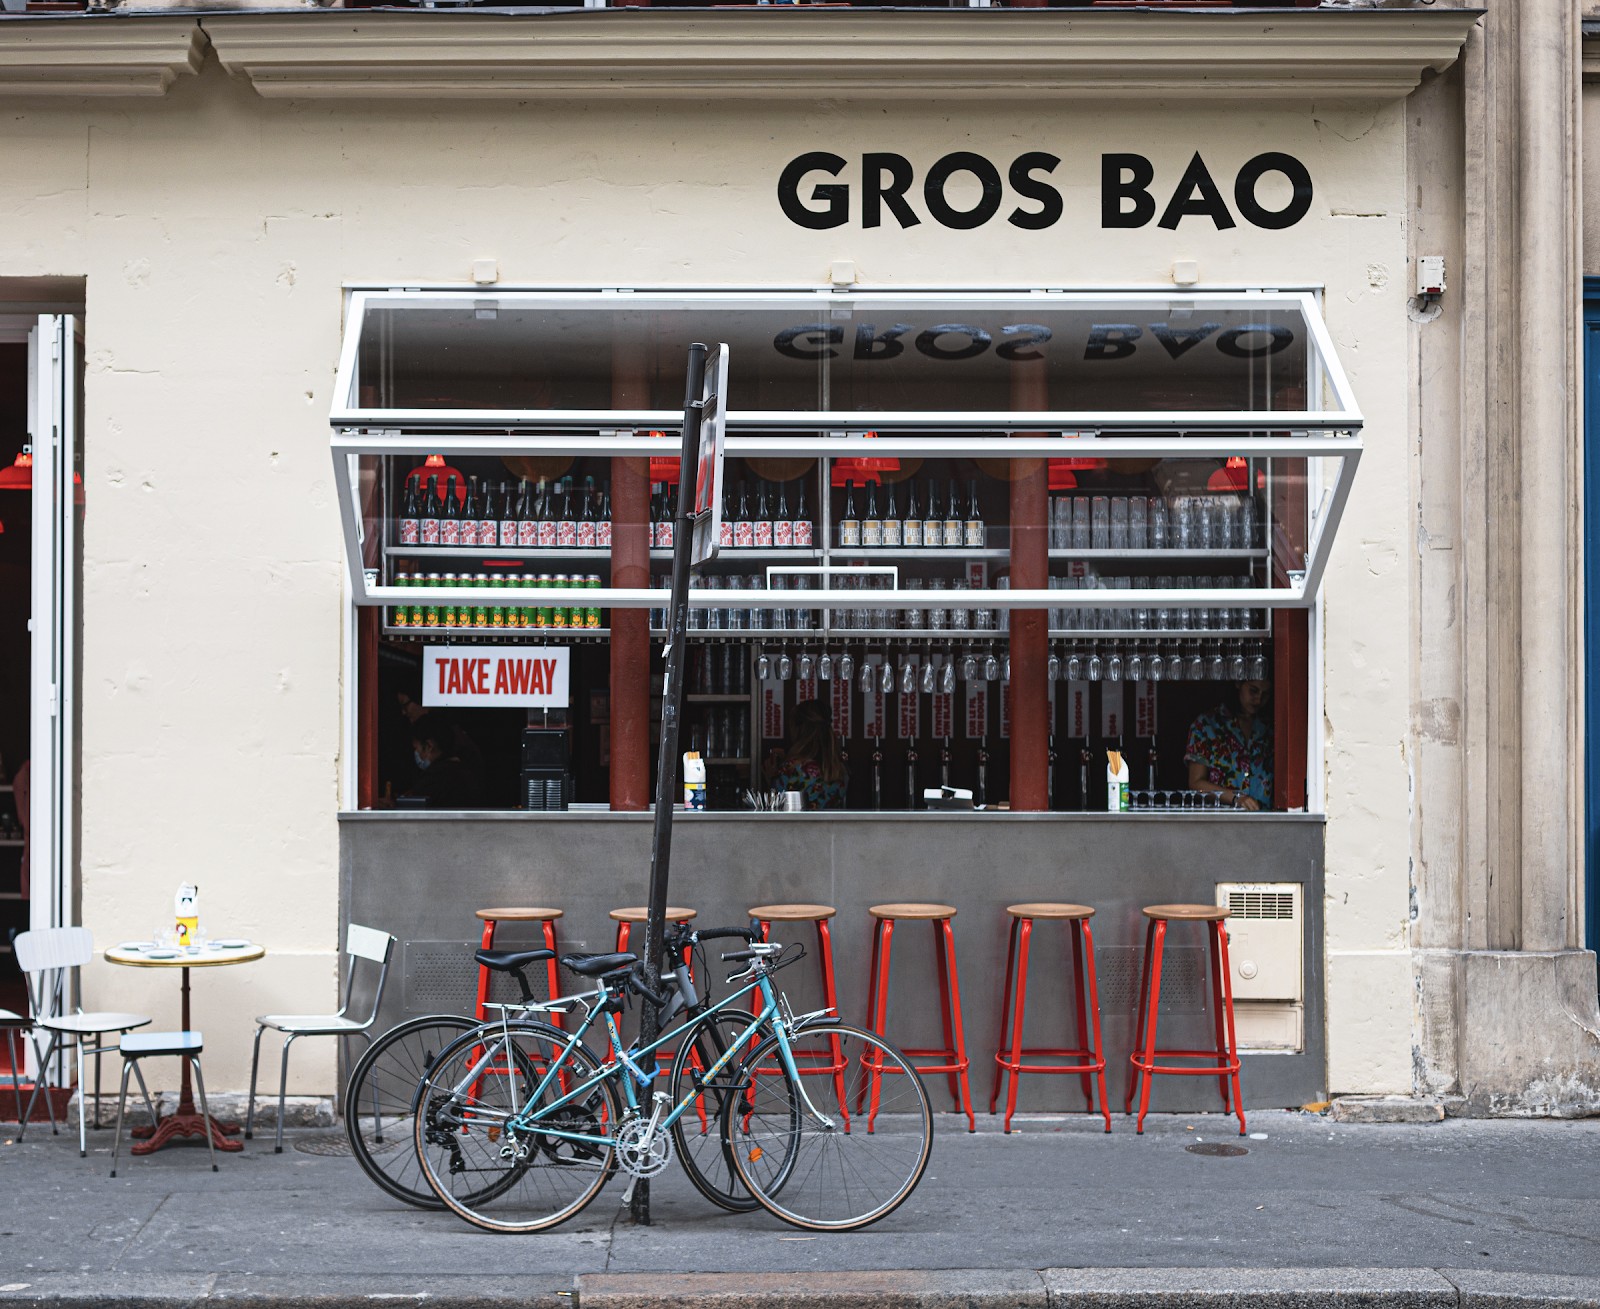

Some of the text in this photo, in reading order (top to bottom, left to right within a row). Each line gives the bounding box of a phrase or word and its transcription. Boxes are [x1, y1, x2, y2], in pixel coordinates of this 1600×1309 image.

[777, 150, 1314, 231] GROS BAO
[435, 658, 557, 695] TAKE AWAY
